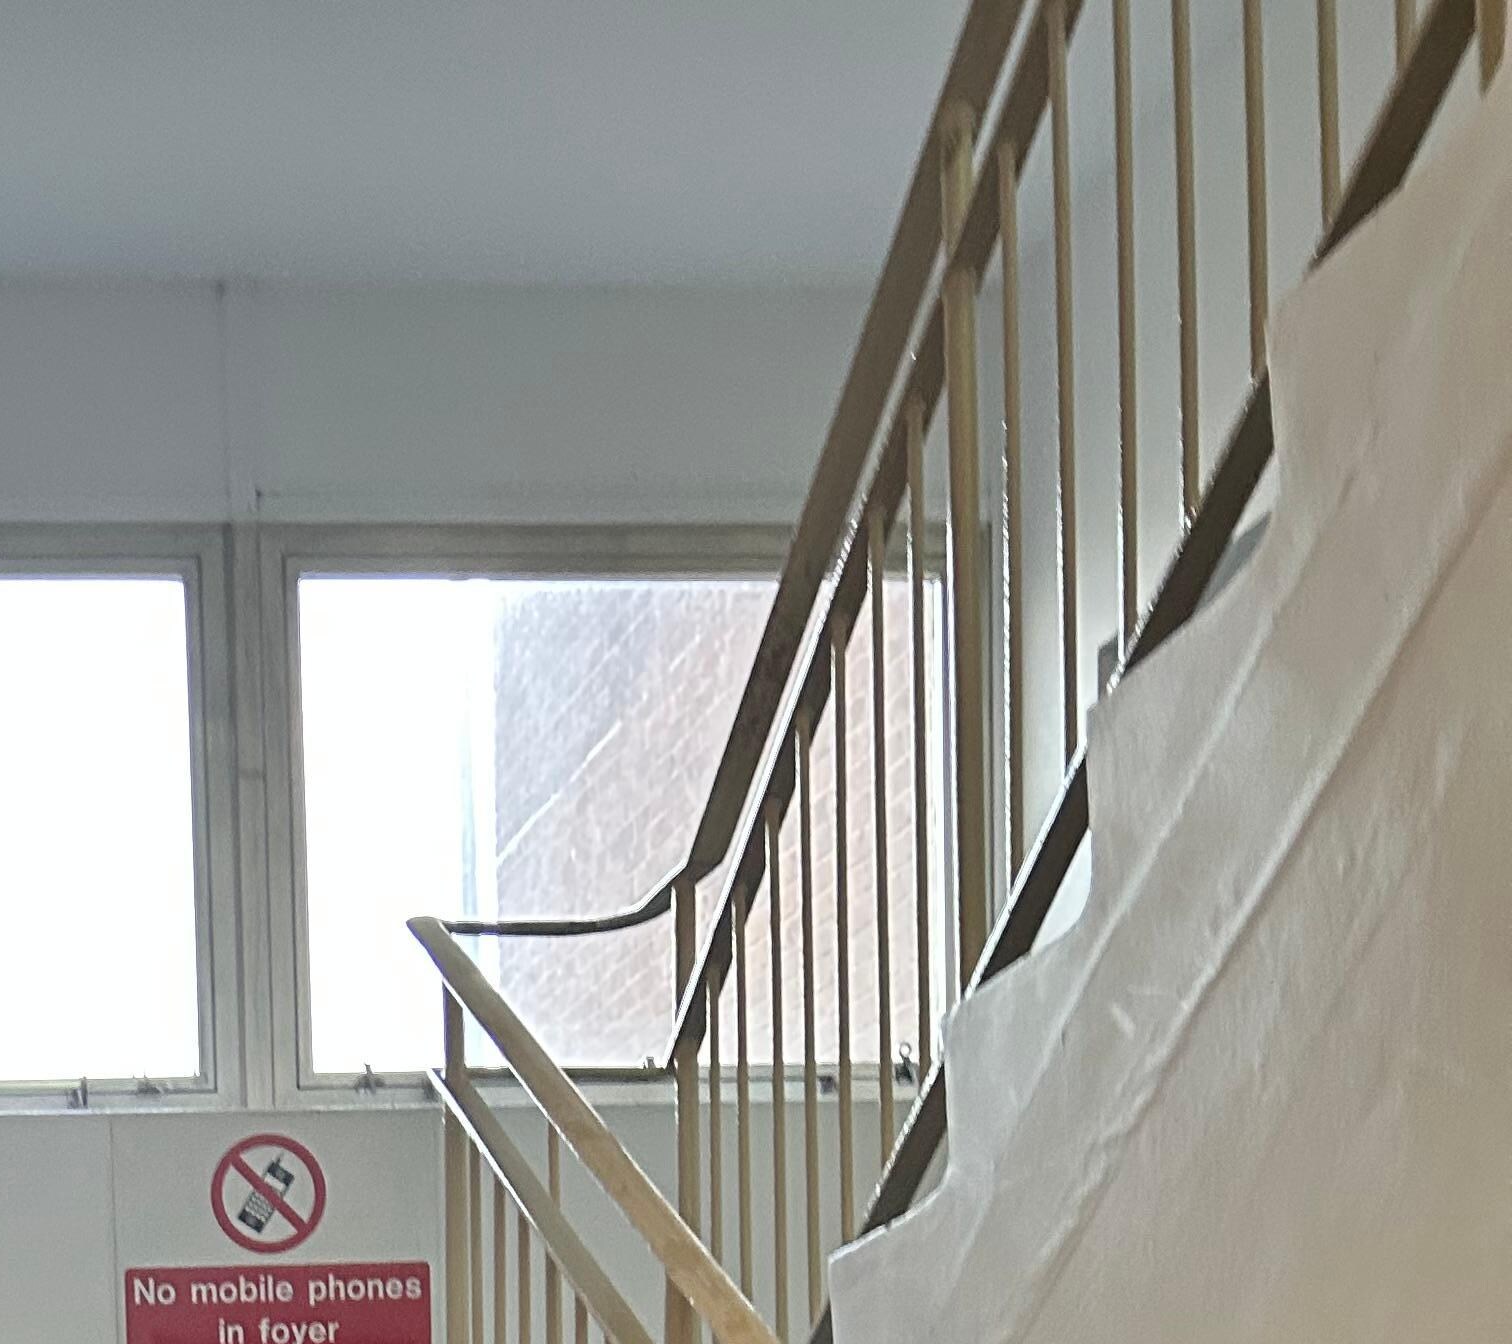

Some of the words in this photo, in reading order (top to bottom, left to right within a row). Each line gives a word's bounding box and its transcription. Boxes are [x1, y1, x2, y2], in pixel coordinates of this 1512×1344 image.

[133, 1277, 176, 1306] No
[191, 1275, 294, 1304] mobile
[308, 1273, 422, 1307] phones
